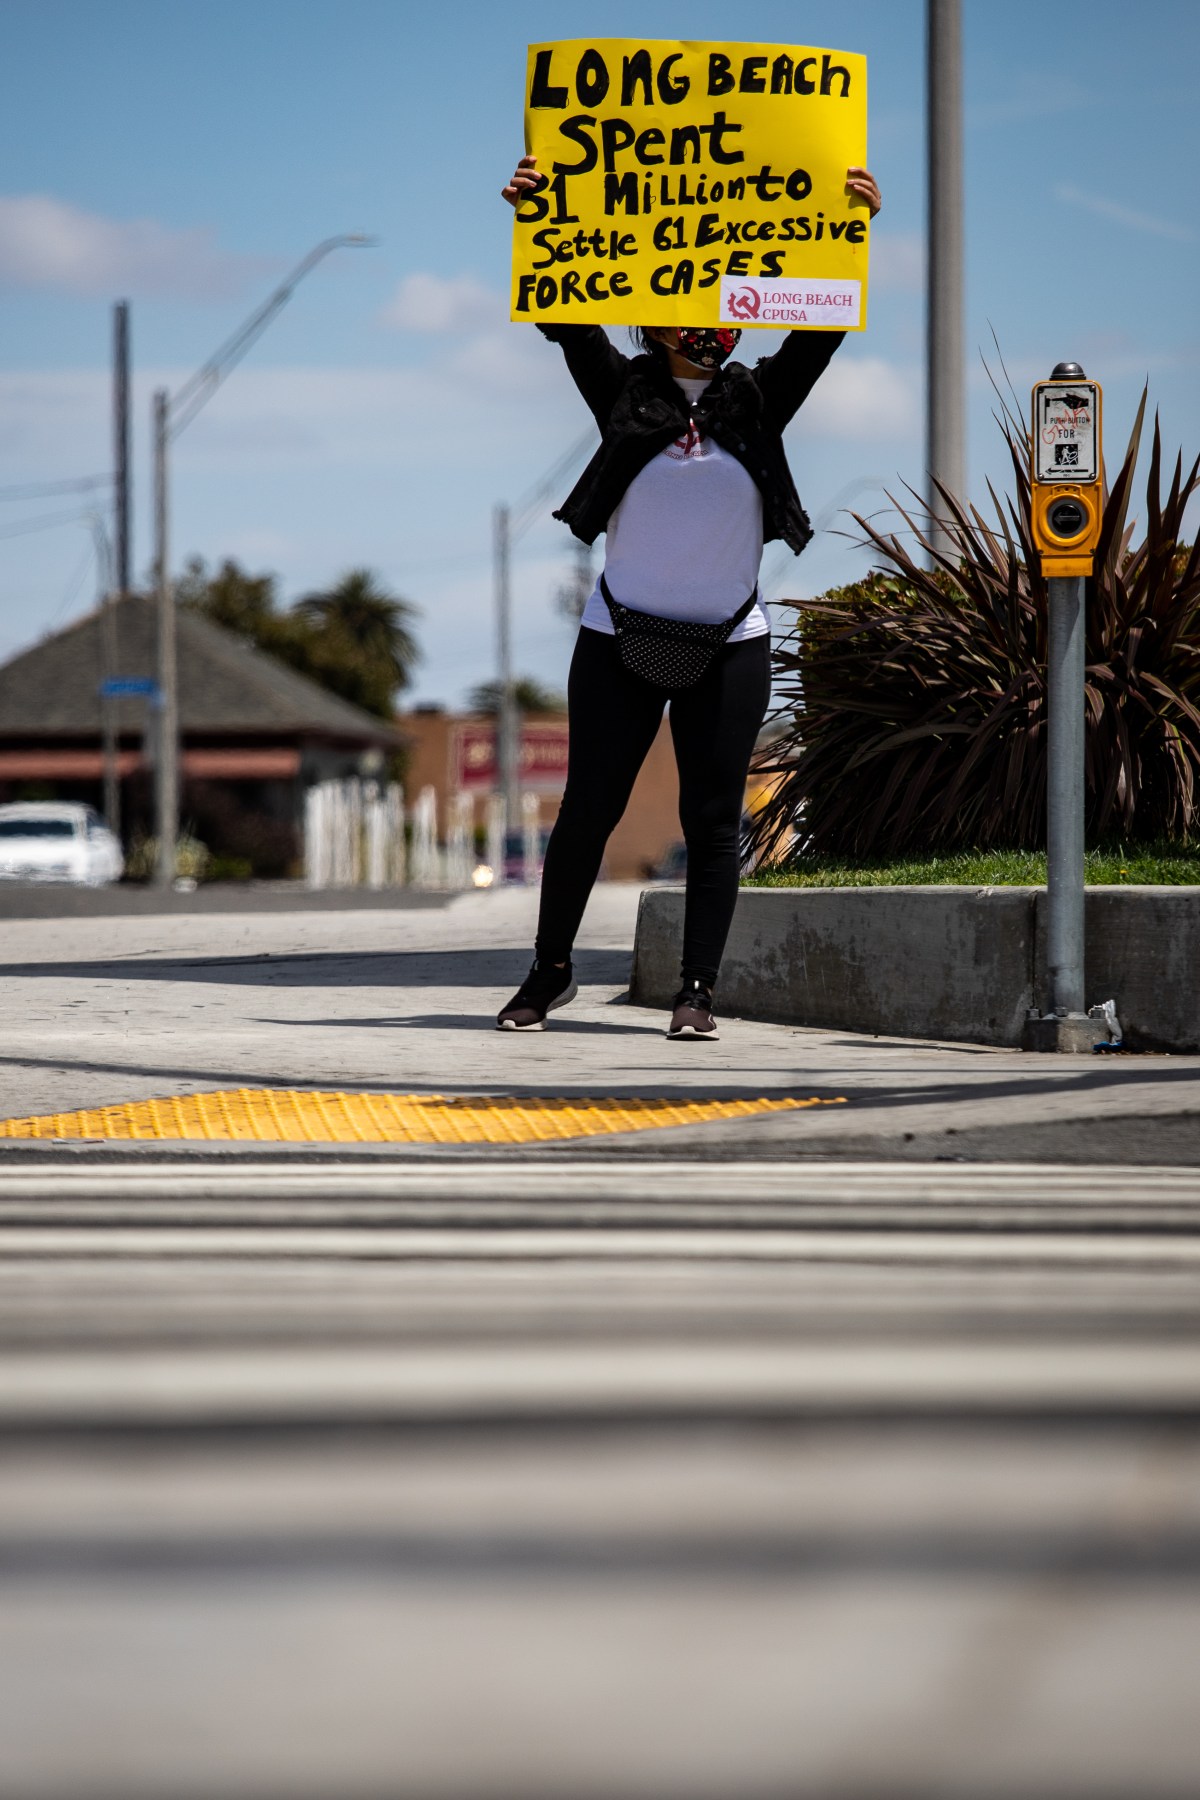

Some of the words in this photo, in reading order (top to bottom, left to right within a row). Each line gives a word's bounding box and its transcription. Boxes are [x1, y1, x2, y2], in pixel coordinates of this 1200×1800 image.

[516, 173, 580, 225] 31
[532, 227, 639, 269] Settle
[653, 216, 688, 251] 61
[695, 212, 867, 248] Excessive
[649, 250, 786, 296] CASES
[763, 292, 802, 304] LONG
[805, 294, 853, 306] BEACH
[762, 309, 808, 321] CPUSA
[1058, 429, 1075, 438] FOR
